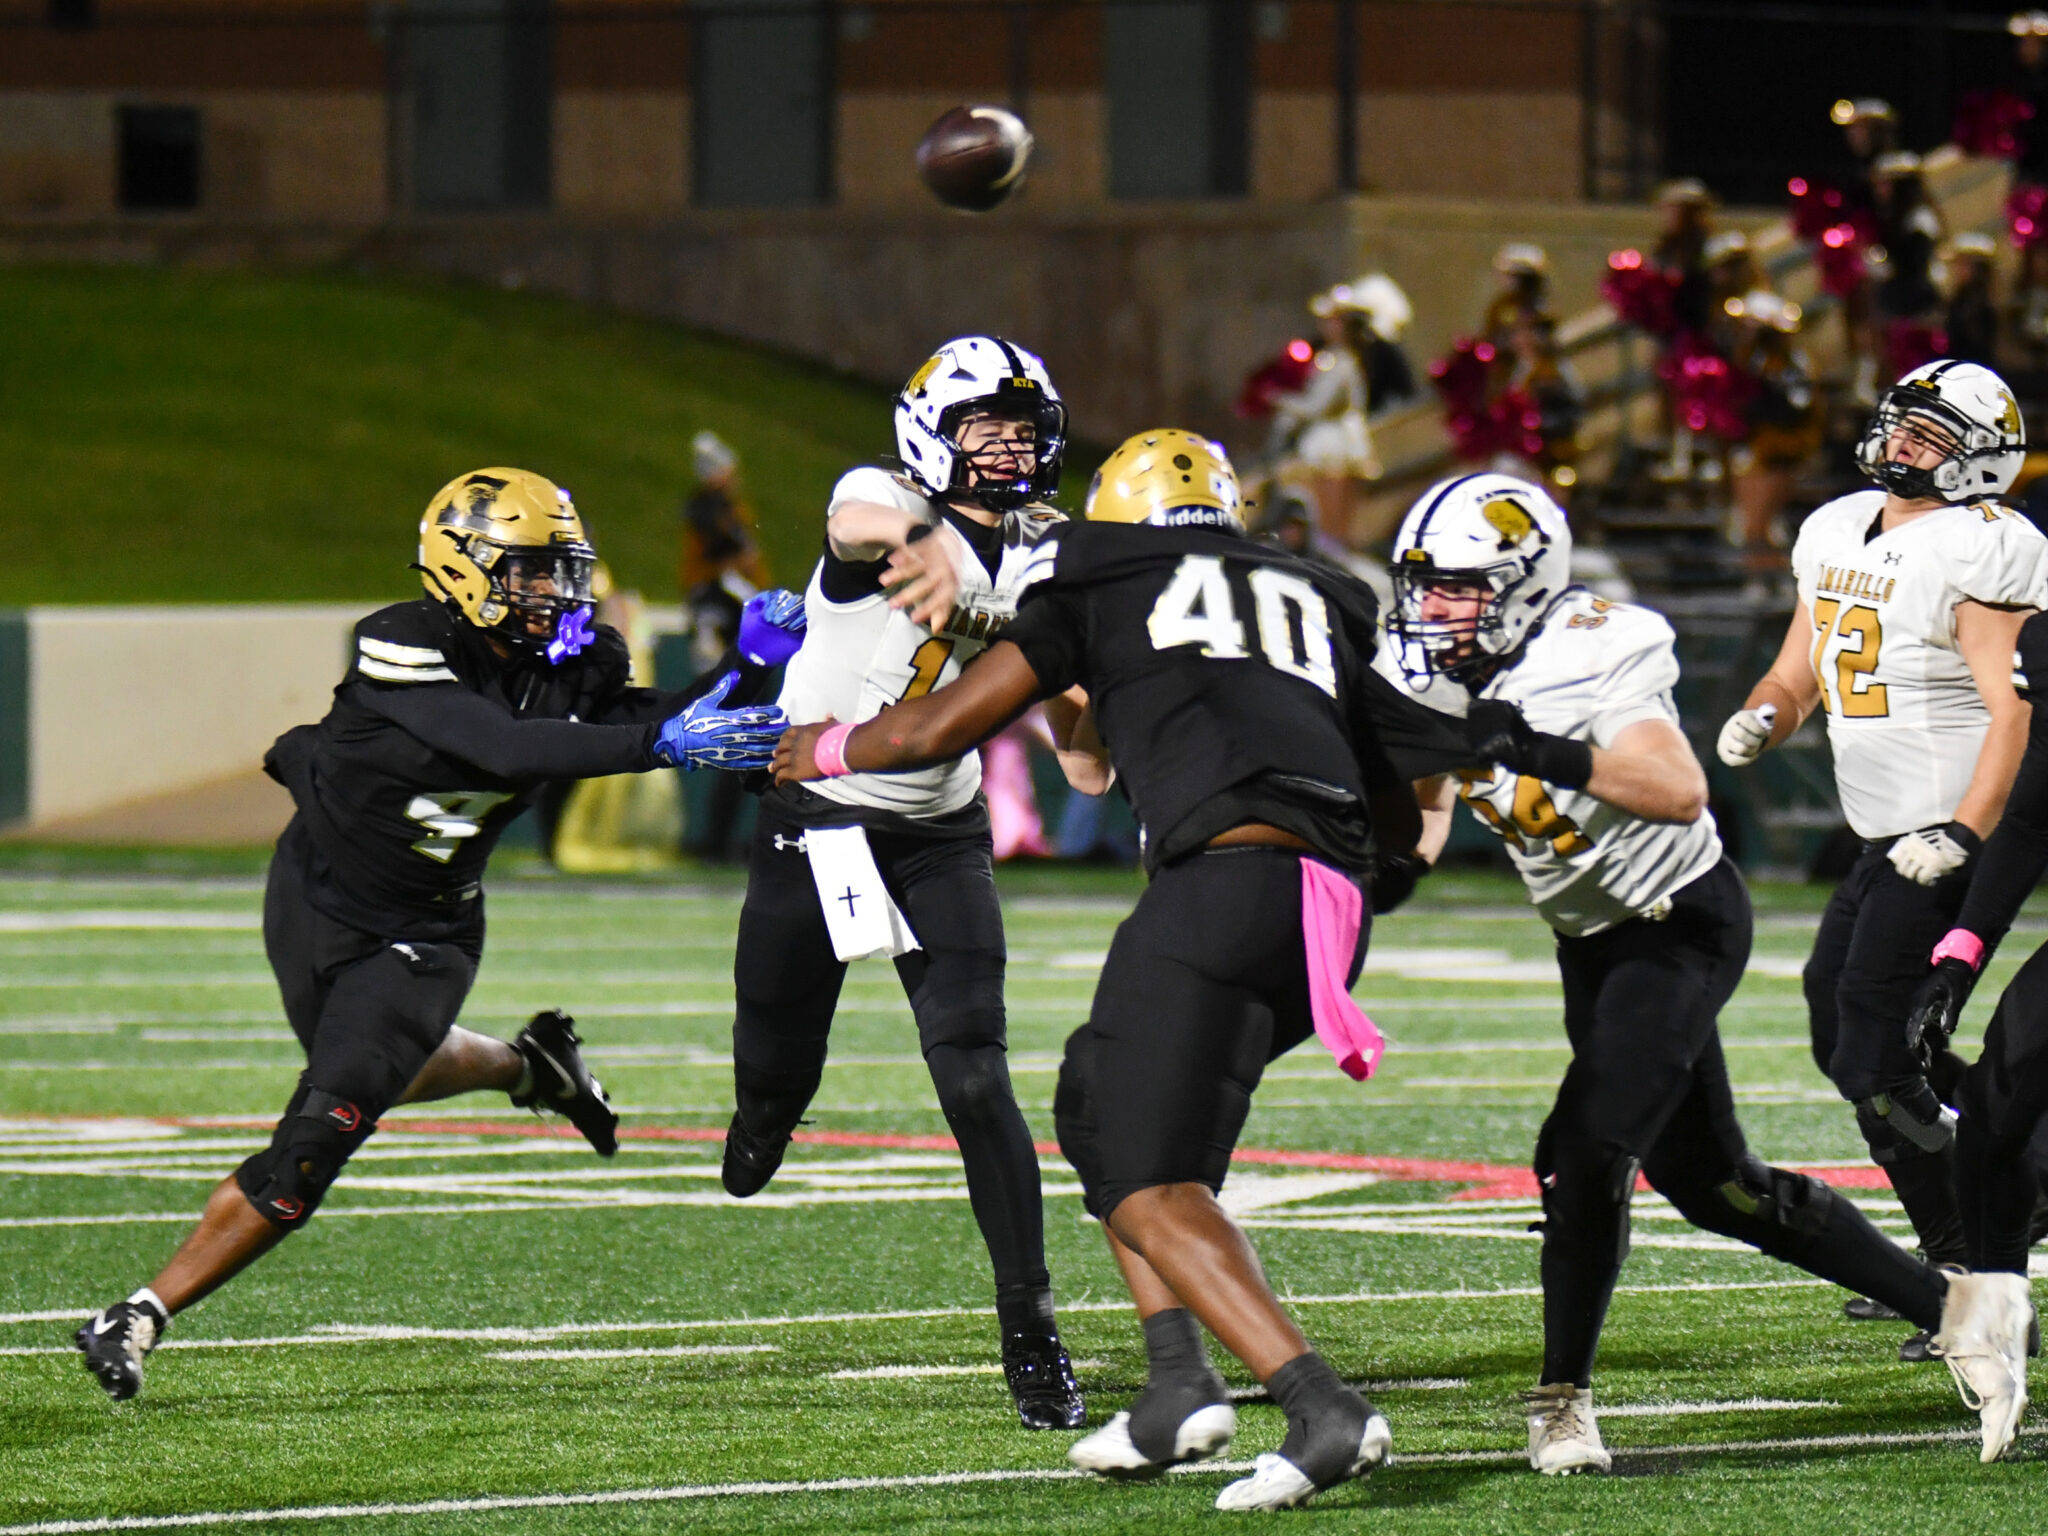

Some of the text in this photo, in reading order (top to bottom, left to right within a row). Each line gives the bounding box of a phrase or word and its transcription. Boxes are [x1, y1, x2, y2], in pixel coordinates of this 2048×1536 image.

[1150, 507, 1229, 526] iddell
[1147, 554, 1337, 699] 40
[1813, 596, 1889, 718] 72
